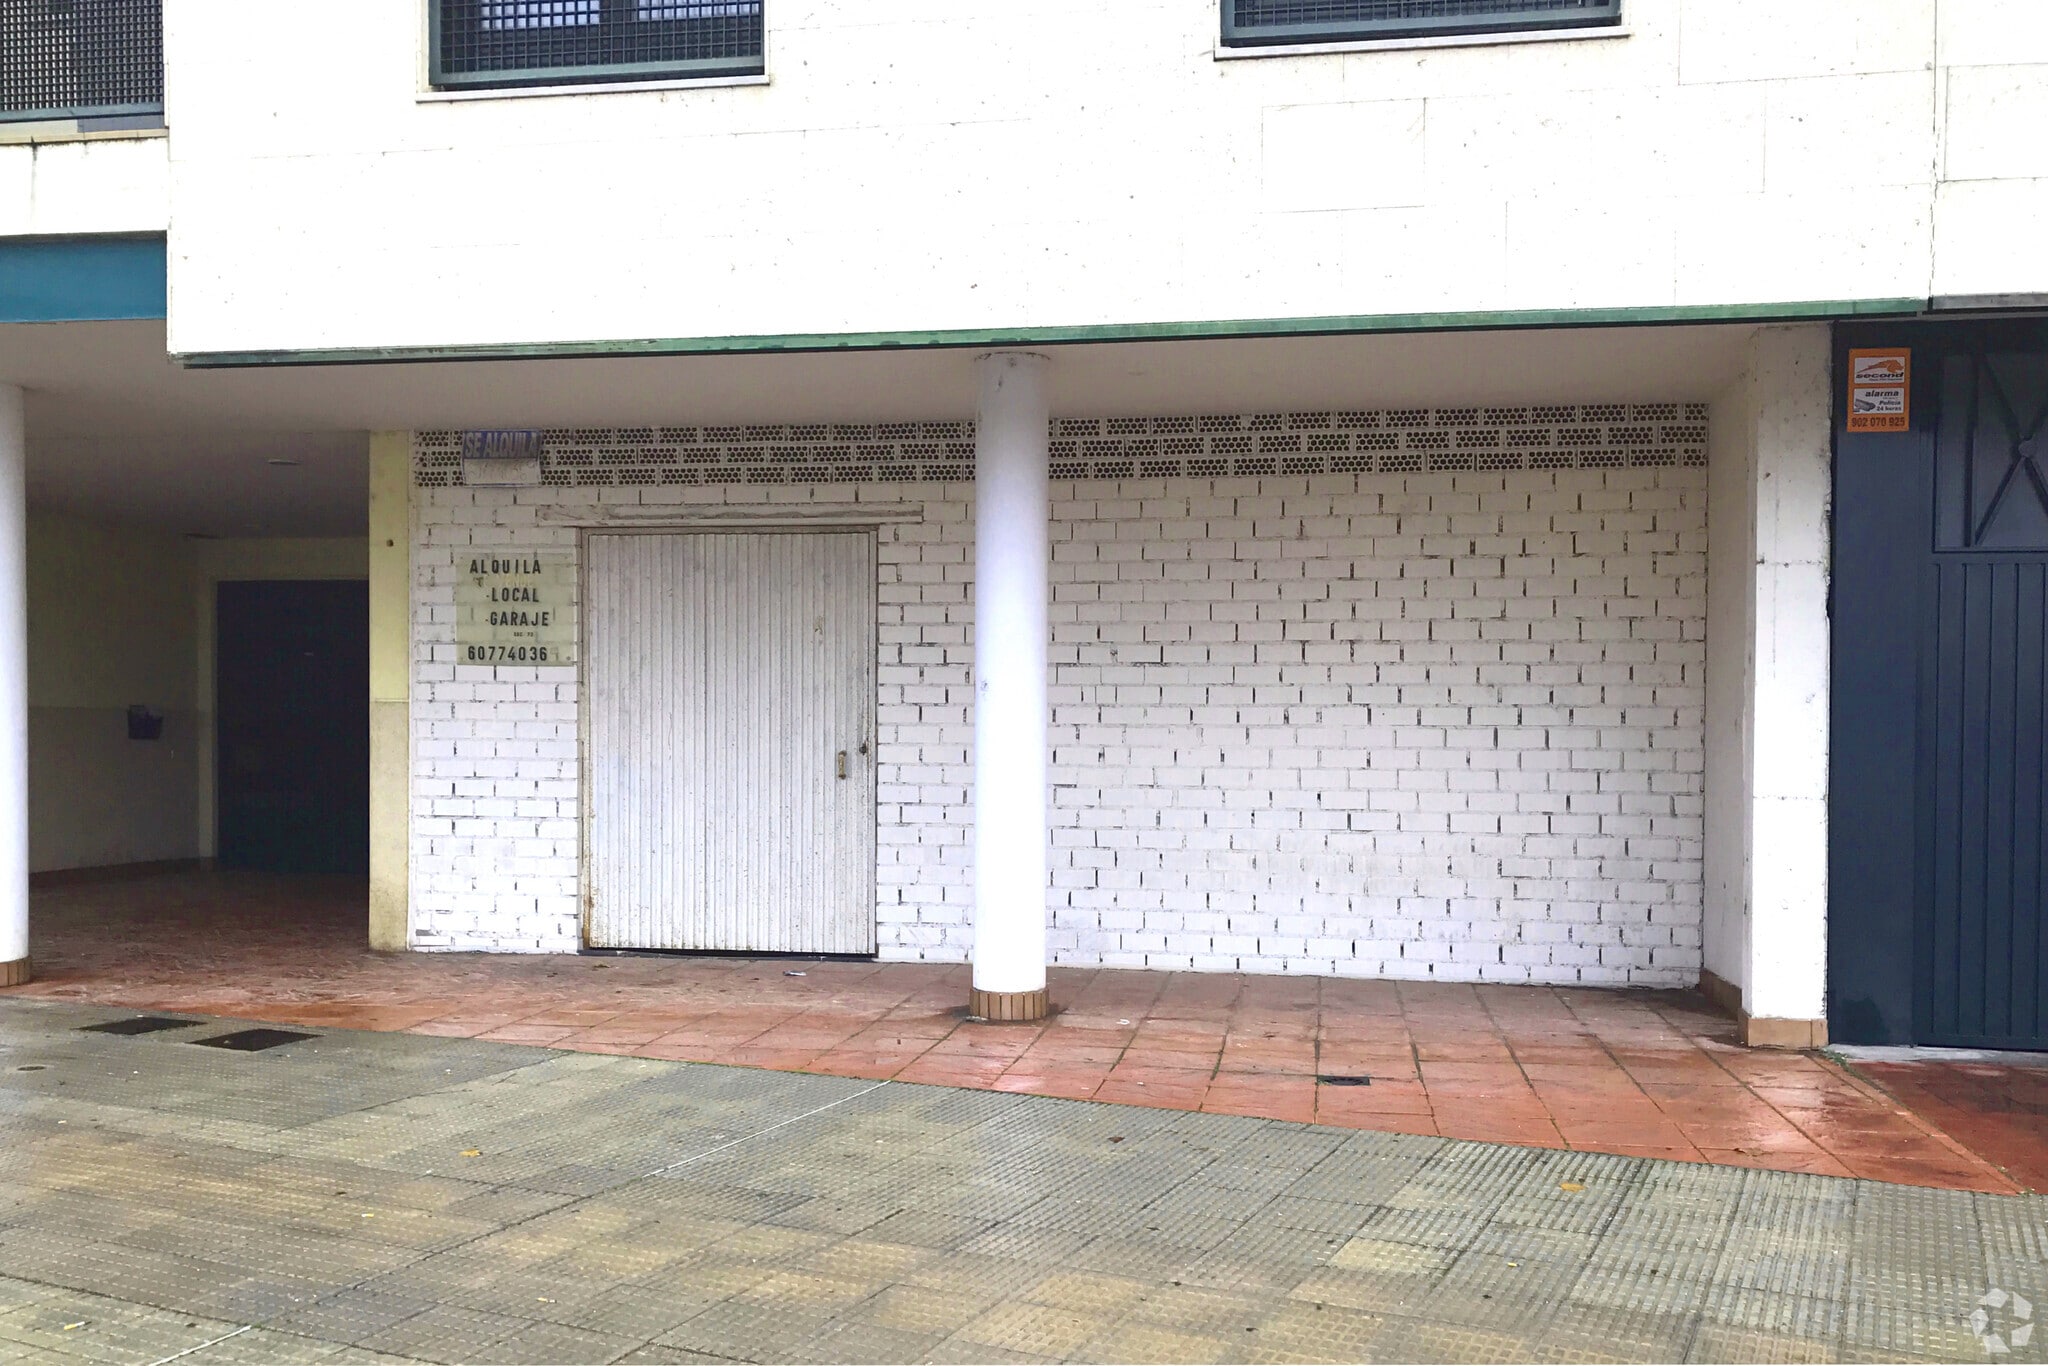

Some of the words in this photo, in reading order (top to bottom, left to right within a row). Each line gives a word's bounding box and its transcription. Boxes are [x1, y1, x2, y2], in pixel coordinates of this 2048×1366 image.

[1852, 417, 1867, 427] 902
[1870, 417, 1887, 427] 070
[1889, 417, 1905, 426] 925
[465, 431, 482, 457] SE
[483, 431, 538, 457] ALQUILA
[469, 559, 541, 574] ALQUILA
